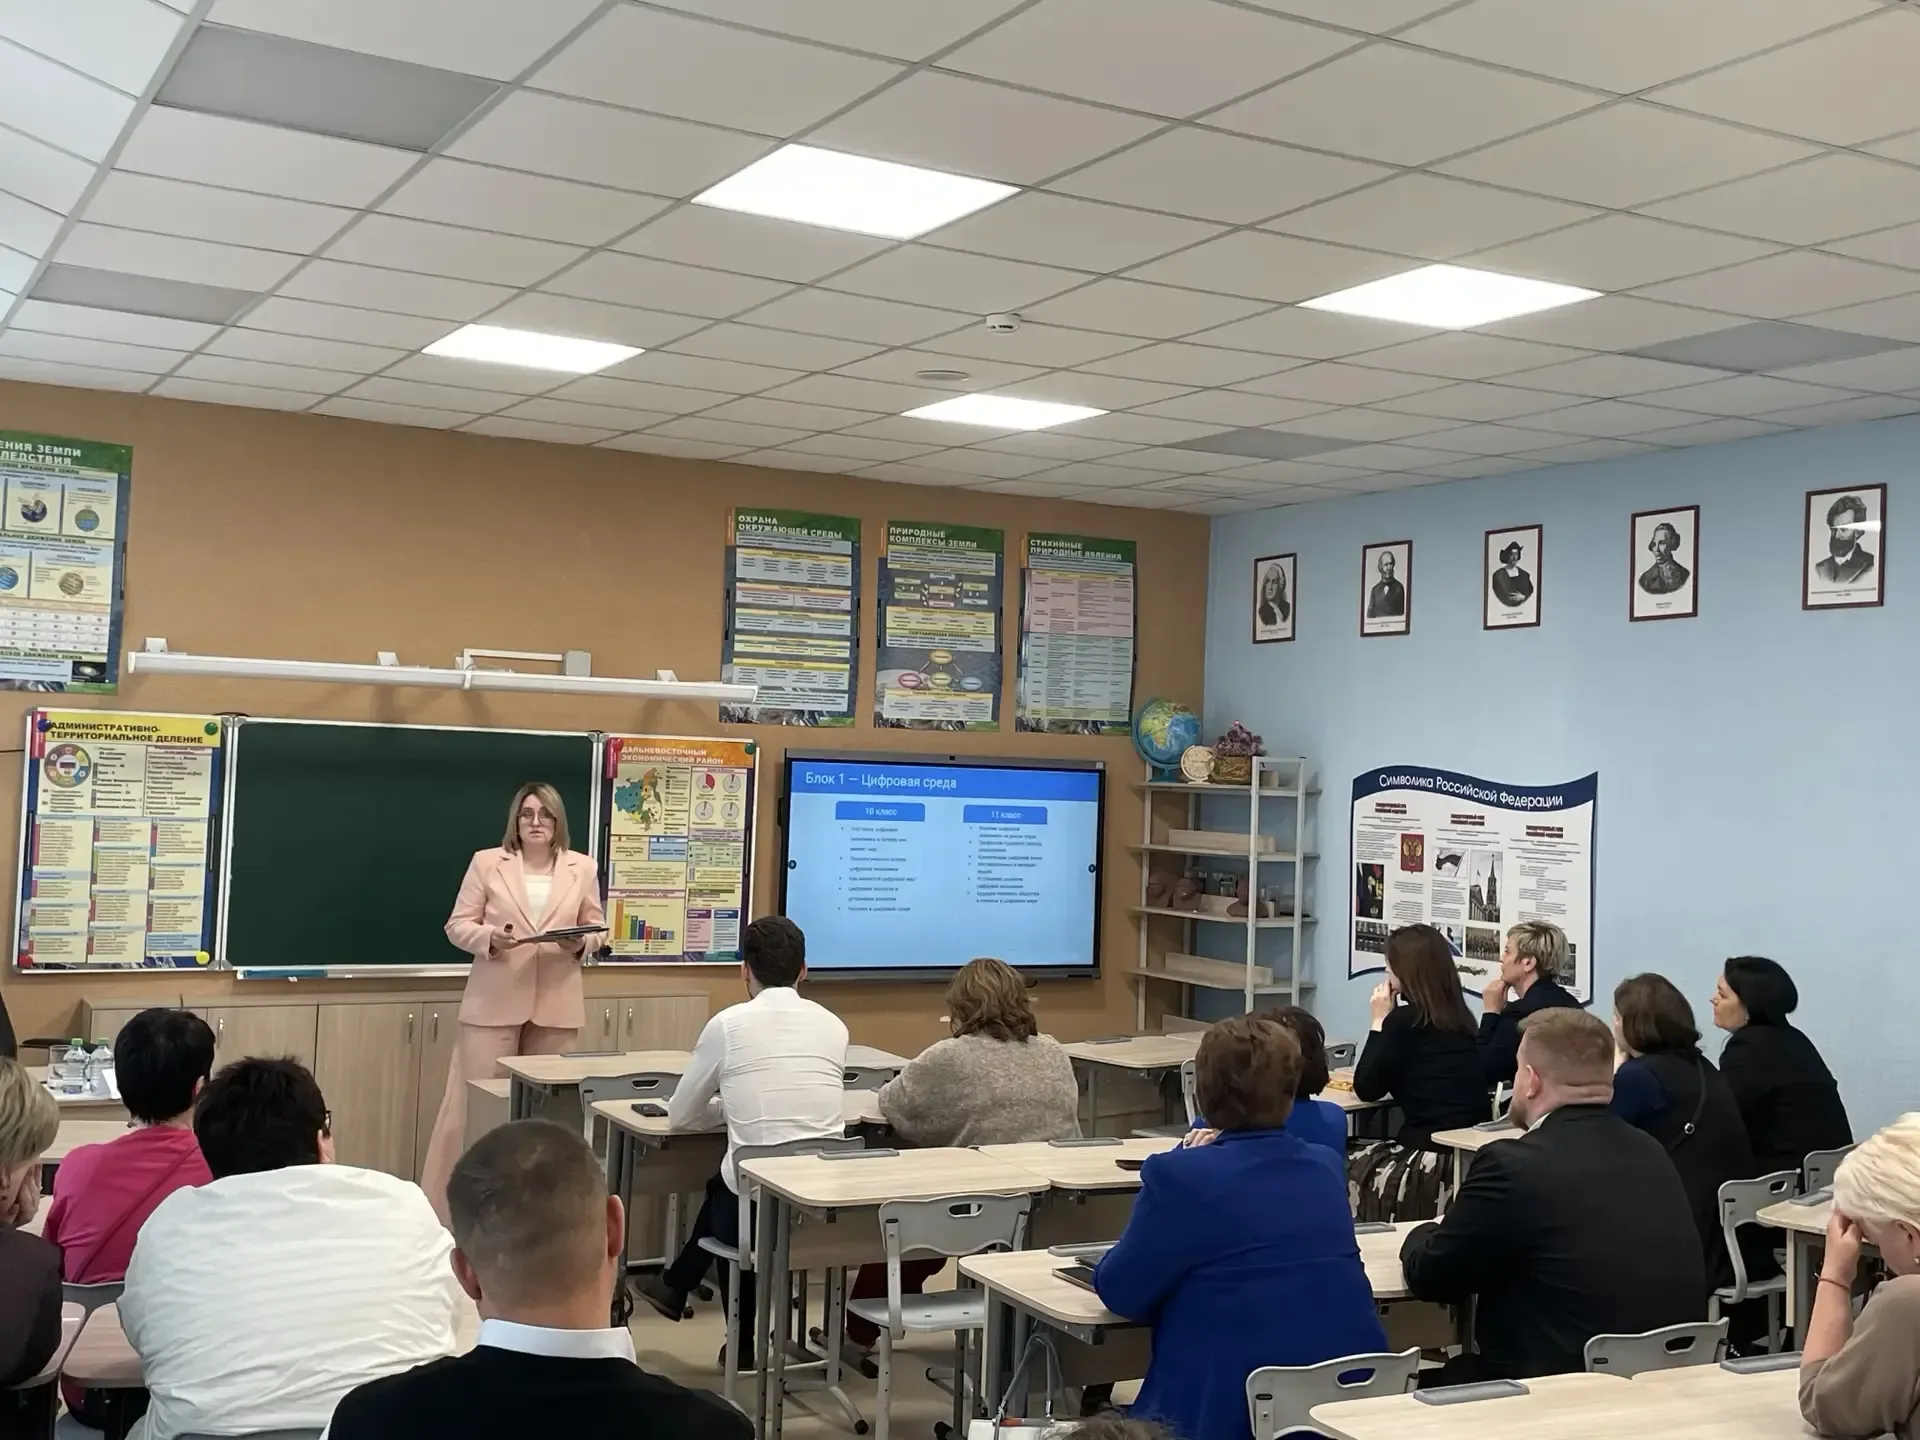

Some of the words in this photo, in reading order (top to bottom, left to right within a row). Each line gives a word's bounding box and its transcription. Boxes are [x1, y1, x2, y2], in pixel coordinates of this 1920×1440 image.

[37, 444, 82, 457] ЗЕМЛИ
[738, 515, 778, 525] ОХРАНА
[738, 523, 808, 536] ОКРУЖАЮЩЕЙ
[810, 529, 842, 539] СРЕДЫ
[889, 527, 946, 538] ПРИРОДНЫЕ
[889, 535, 946, 546] КОМПЛЕКСЫ
[948, 540, 977, 548] ЗЕМЛИ
[1030, 539, 1083, 549] СТИХИЙНЫЕ
[1030, 547, 1083, 557] ПРИРОДНЫЕ
[1085, 551, 1122, 560] ЯВЛЕНИЯ
[51, 721, 160, 733] АДМИНИСТРАТИВНО-
[51, 731, 153, 742] ТЕРРИТОРИАЛЬНОЕ
[155, 735, 203, 744] ДЕЛЕНИЕ
[621, 754, 695, 764] ЭКОНОМИЧЕСКИЙ
[696, 756, 724, 765] РАЙОН
[805, 772, 836, 785] Блок
[838, 773, 845, 785] 1
[861, 774, 920, 789] Цифровая
[923, 778, 957, 790] среда
[1379, 774, 1434, 788] Символика
[1436, 776, 1498, 802] Российской
[1499, 791, 1563, 810] Федерации
[865, 807, 875, 816] 10
[875, 808, 898, 817] класс
[991, 810, 999, 819] 11
